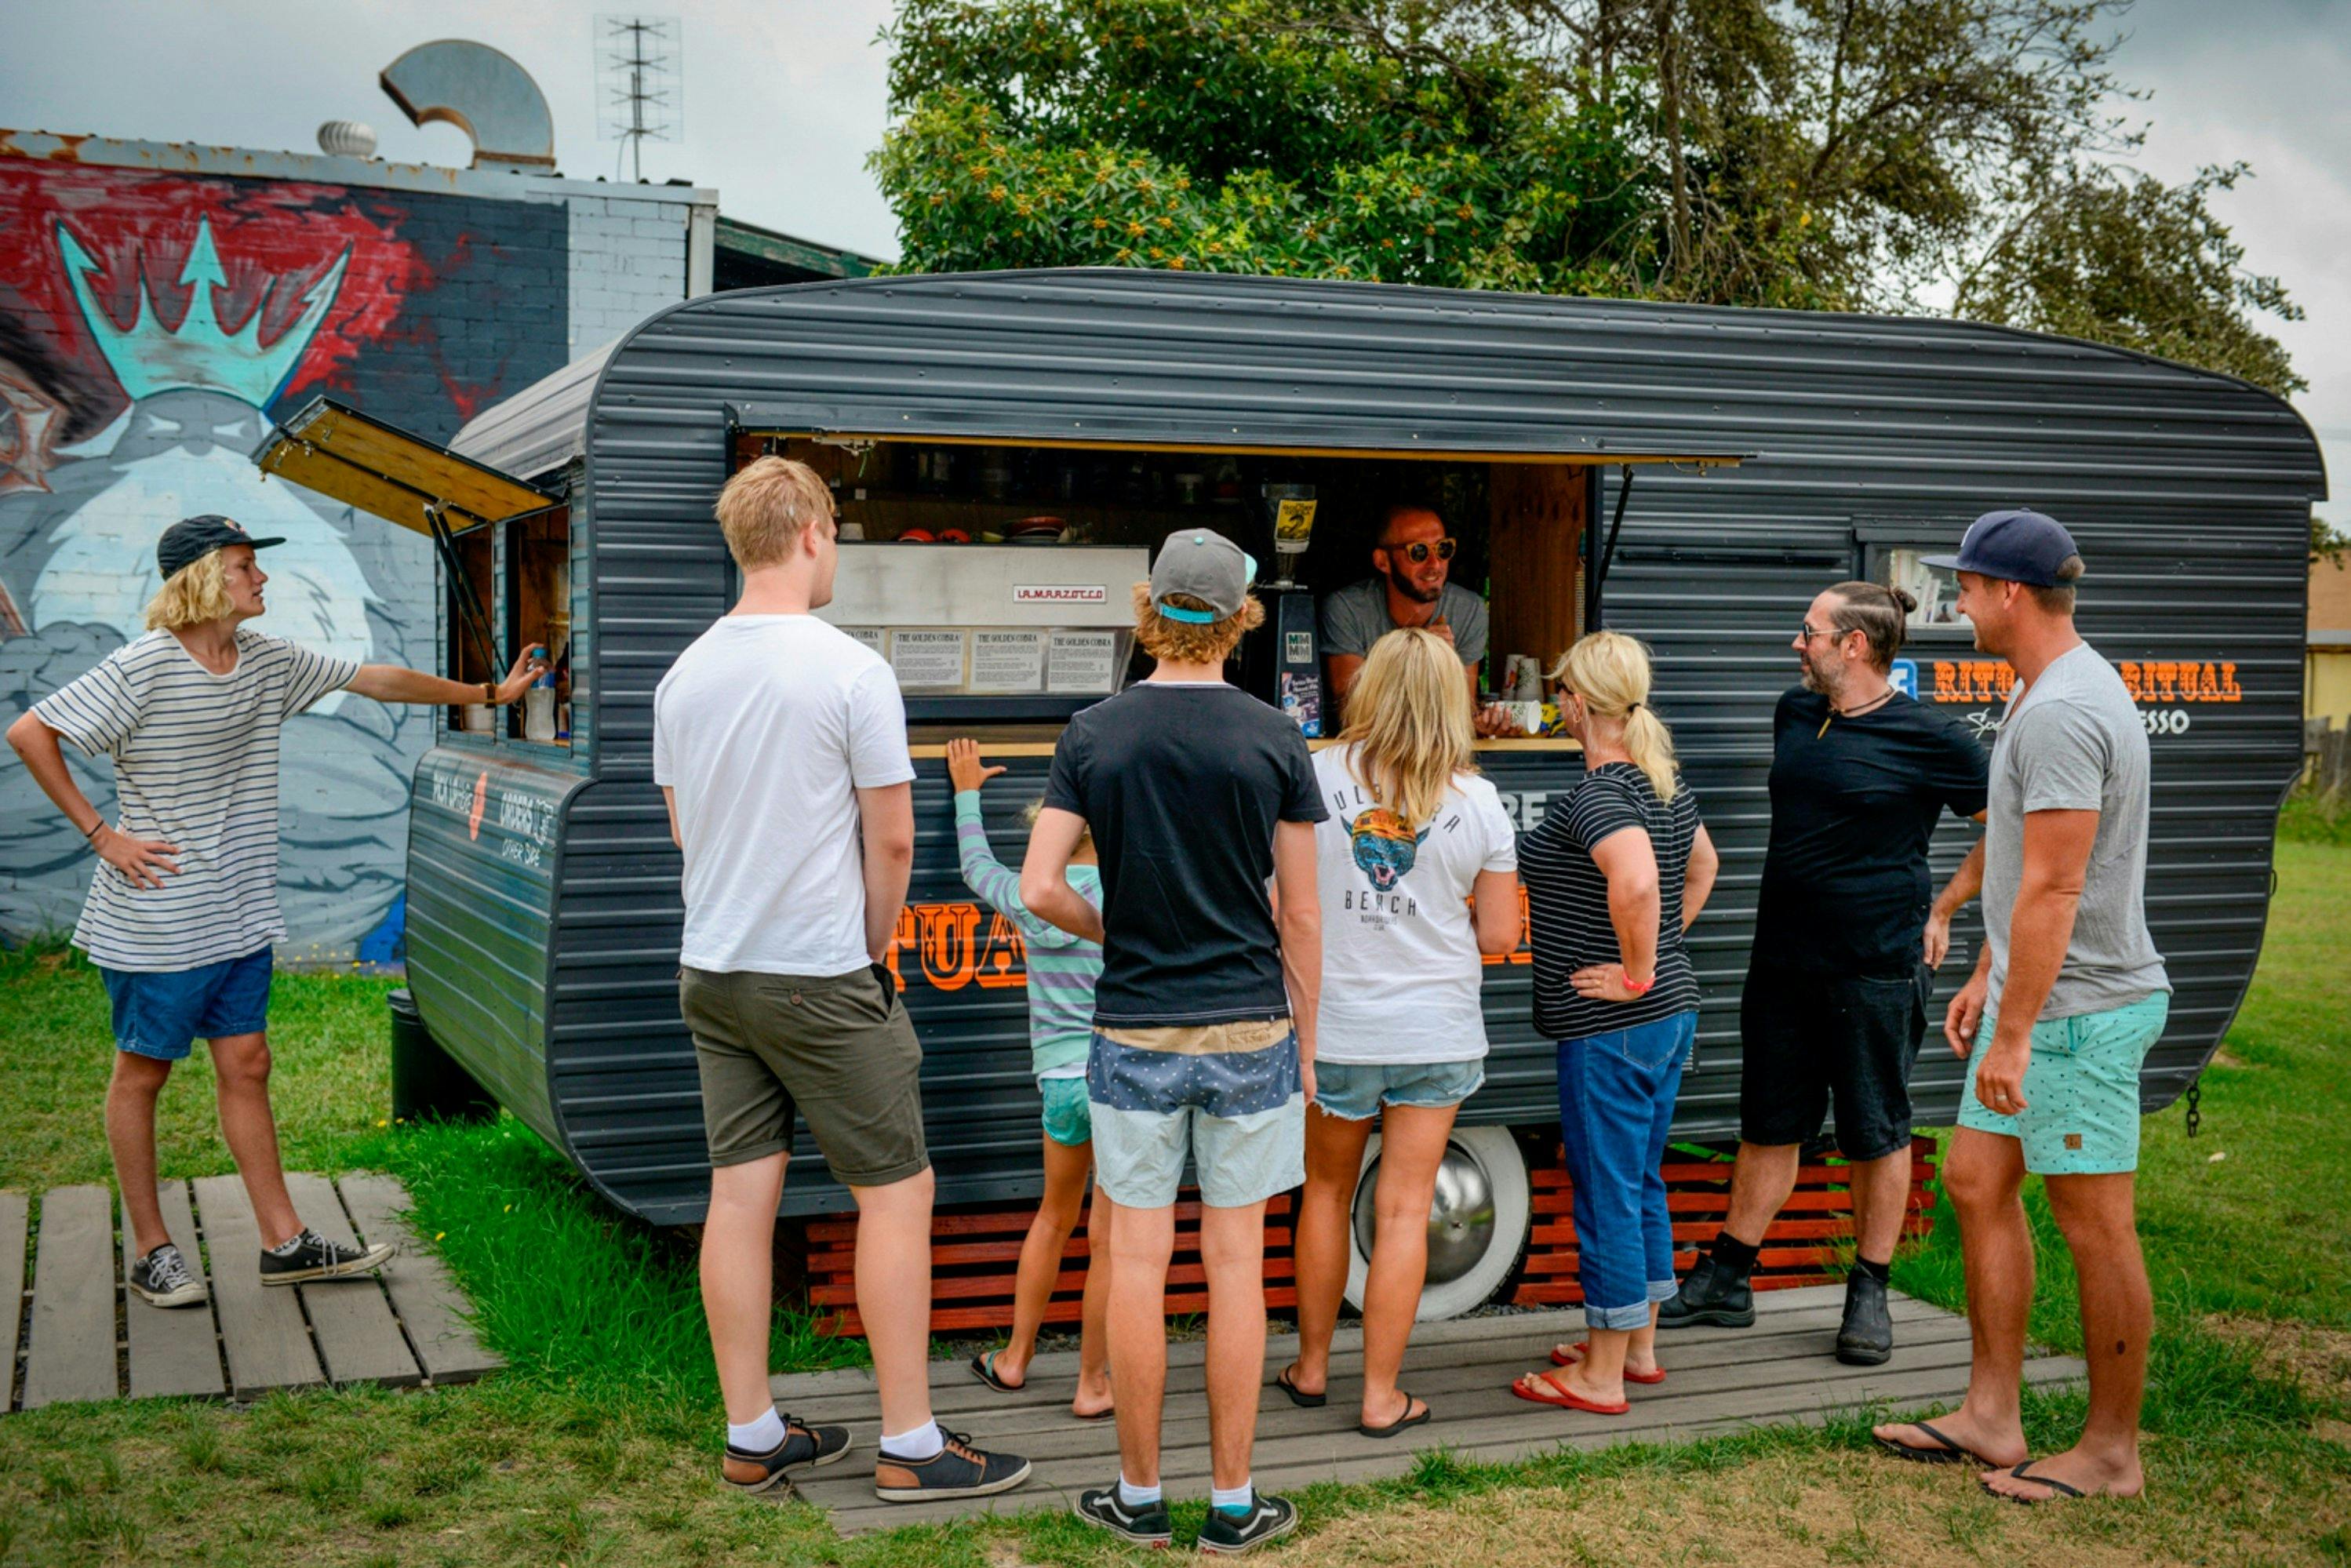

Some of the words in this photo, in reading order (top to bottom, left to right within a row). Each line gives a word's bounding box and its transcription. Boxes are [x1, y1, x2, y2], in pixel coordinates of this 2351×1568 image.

[899, 633, 910, 642] THE
[978, 634, 989, 642] THE
[1054, 638, 1065, 646] THE
[1345, 890, 1417, 916] BEACH
